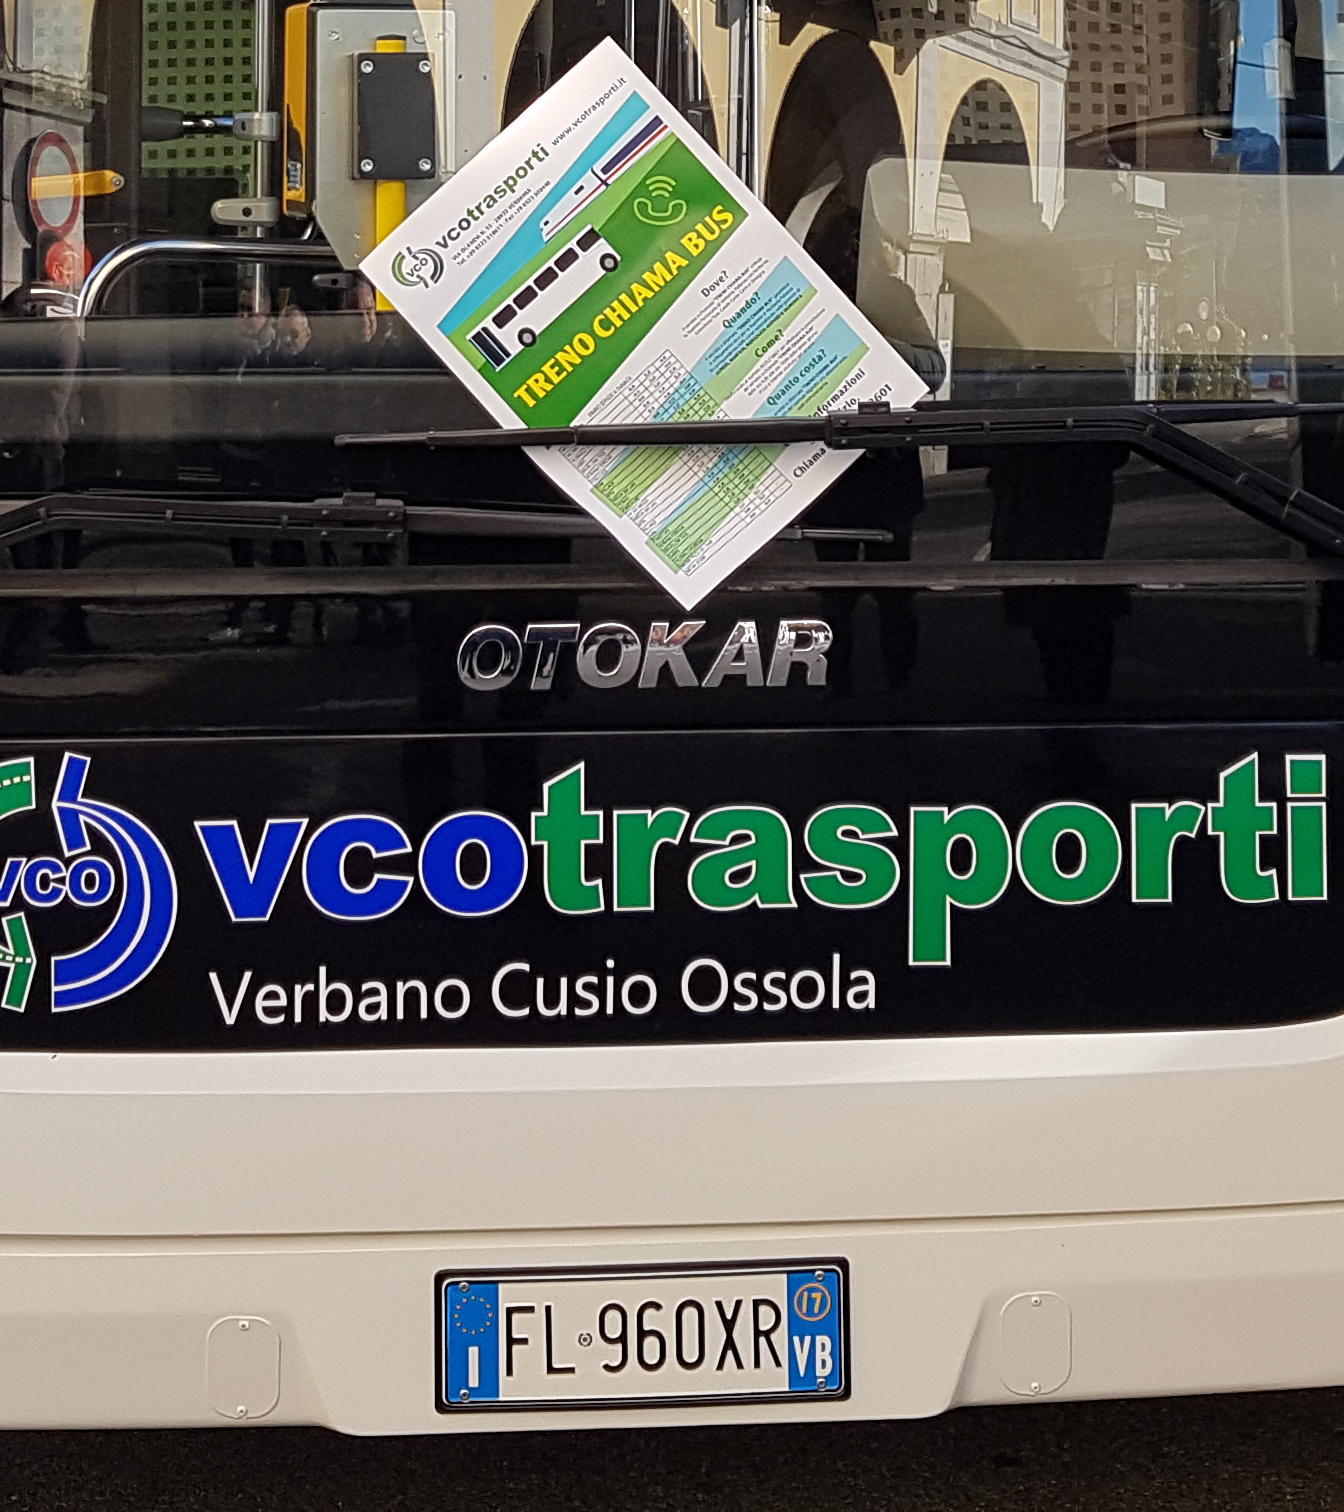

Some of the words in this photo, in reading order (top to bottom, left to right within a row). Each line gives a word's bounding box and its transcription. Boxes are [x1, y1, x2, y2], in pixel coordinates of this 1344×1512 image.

[552, 78, 626, 145] www.vcotrasporti.it
[435, 142, 550, 250] vcotrasporti
[513, 332, 595, 408] TRENO
[594, 251, 688, 337] CHIAMA
[681, 206, 733, 256] BUS
[701, 271, 728, 297] Dove?
[723, 292, 760, 329] Quando?
[755, 329, 784, 360] Come?
[767, 377, 799, 405] Quanto
[800, 349, 826, 377] costa?
[808, 368, 866, 419] nformazioni
[794, 448, 826, 477] Chiama
[457, 619, 833, 690] OTOKAR
[193, 751, 1329, 966] vcotrasporti
[208, 965, 472, 1026] Verbano
[490, 958, 658, 1018] Cusio
[680, 953, 878, 1012] Ossola
[792, 1334, 834, 1378] VB
